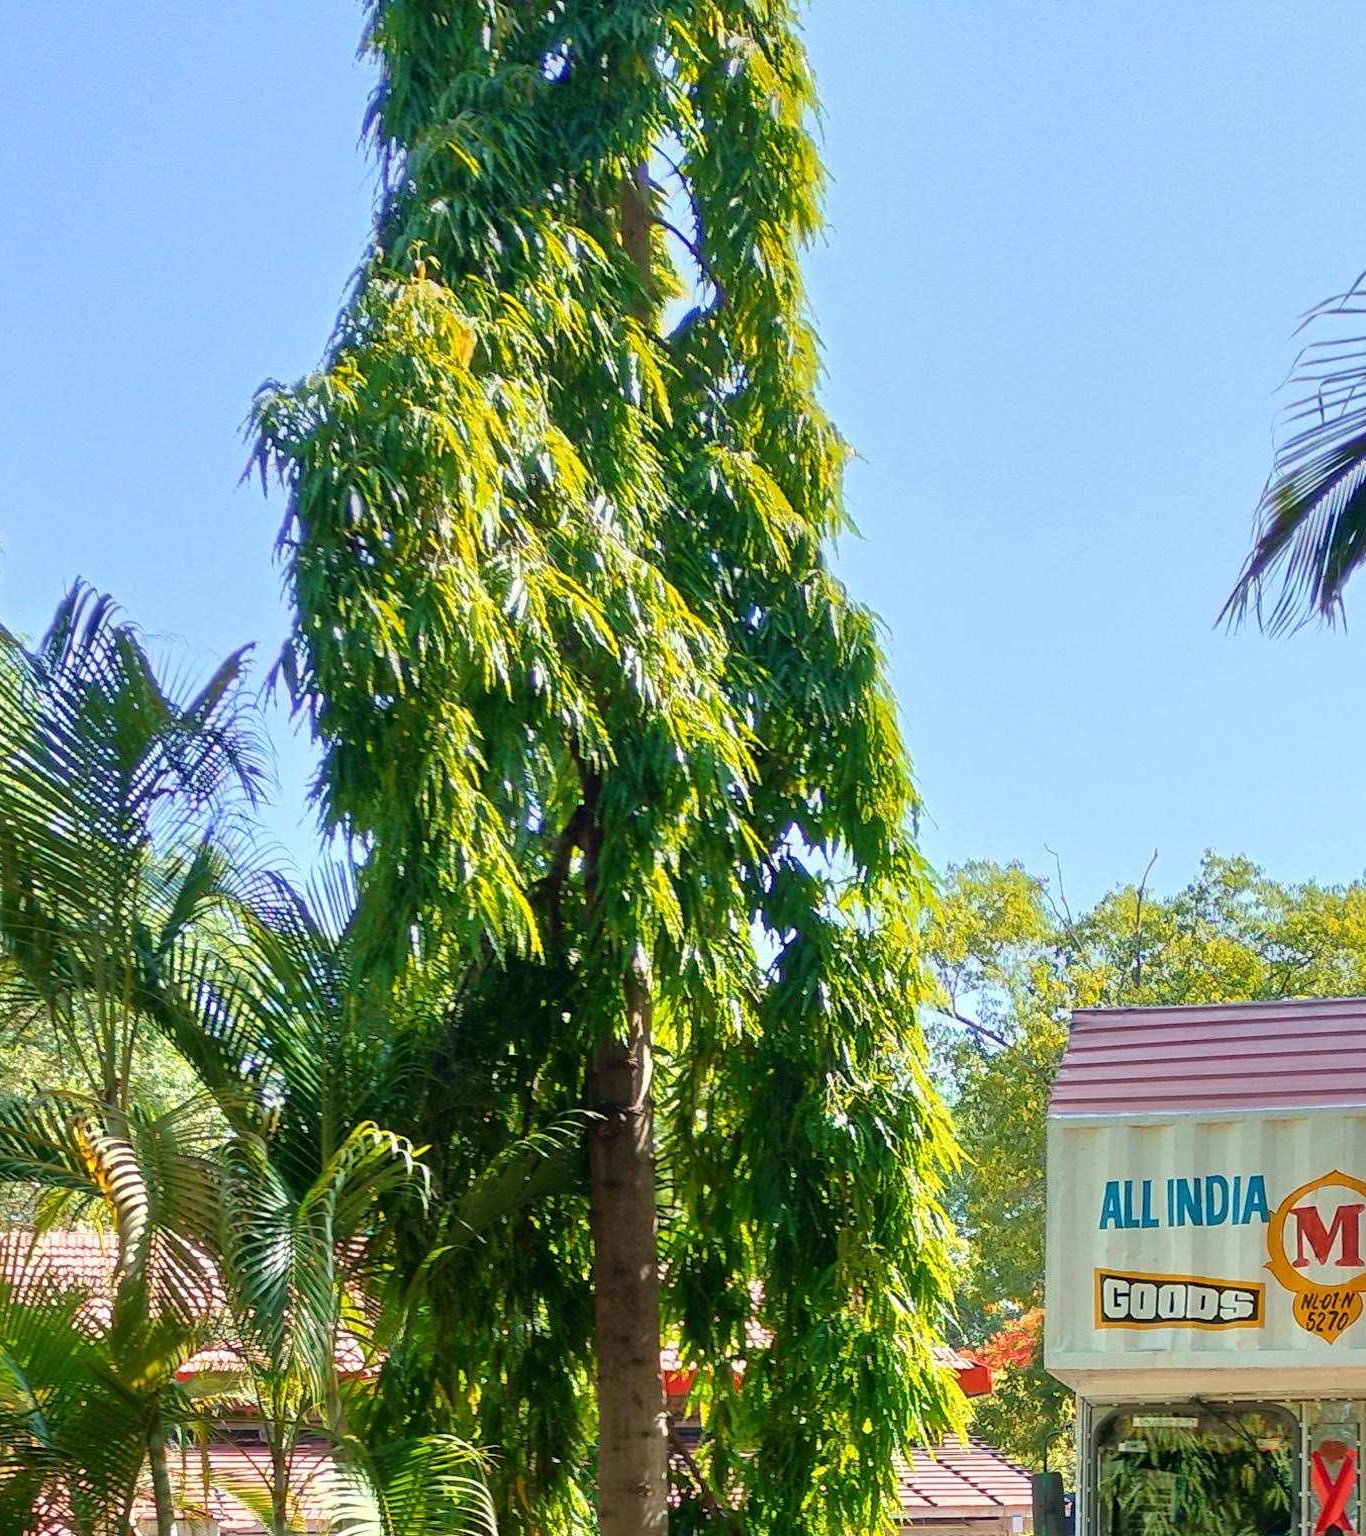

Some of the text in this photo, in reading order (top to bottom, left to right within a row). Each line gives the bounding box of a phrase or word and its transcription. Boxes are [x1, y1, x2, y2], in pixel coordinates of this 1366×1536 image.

[1099, 1180, 1159, 1229] ALL
[1167, 1175, 1269, 1227] INDIA
[1290, 1204, 1365, 1267] M
[1102, 1278, 1255, 1321] GOODS
[1306, 1311, 1349, 1331] 5270
